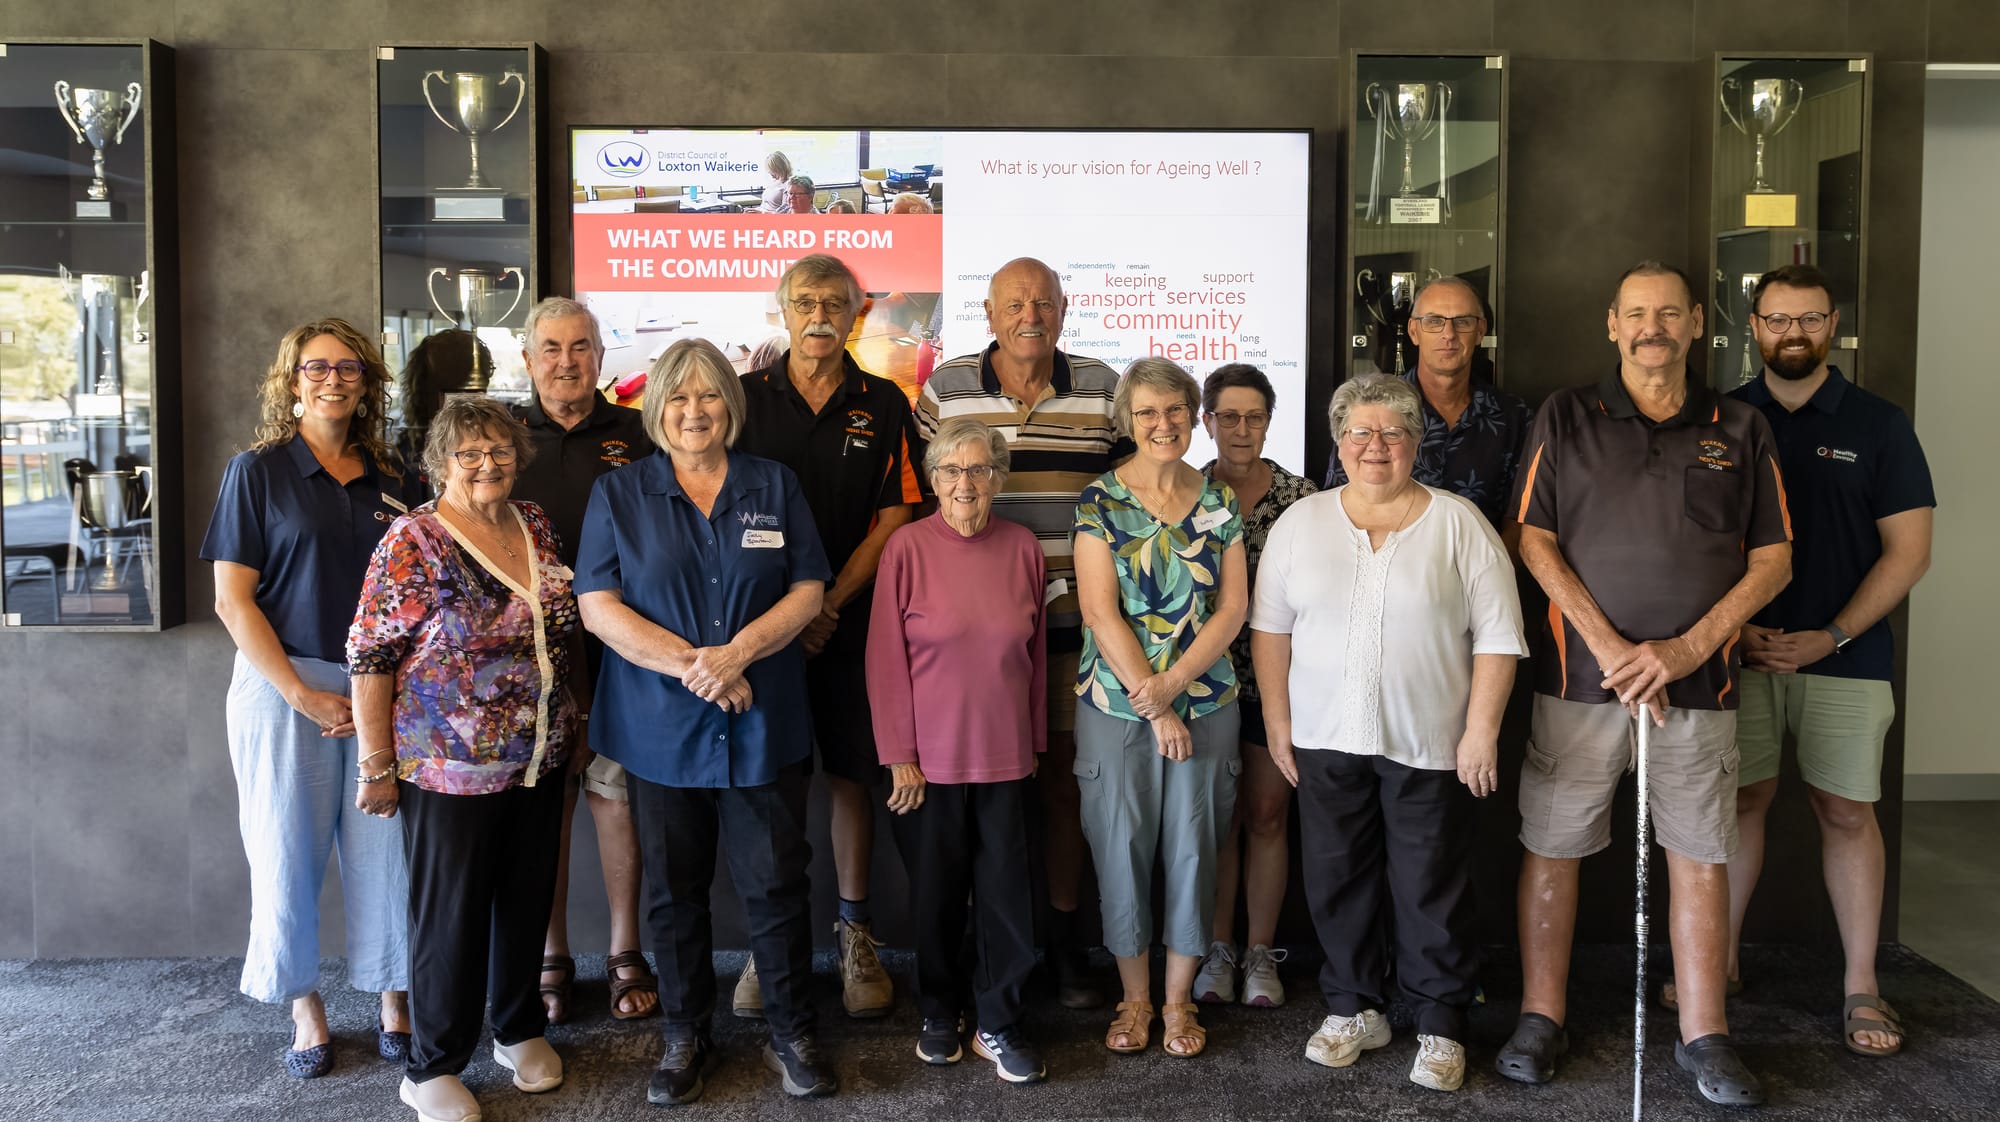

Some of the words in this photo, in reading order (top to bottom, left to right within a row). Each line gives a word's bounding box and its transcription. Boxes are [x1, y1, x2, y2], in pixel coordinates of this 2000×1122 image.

[657, 151, 686, 159] District
[687, 151, 718, 159] Council
[719, 151, 728, 159] of
[658, 161, 700, 172] Loxton
[704, 161, 759, 172] Waikerie
[980, 159, 1022, 177] What
[1027, 159, 1038, 177] is
[1041, 162, 1078, 181] your
[1081, 159, 1125, 177] vision
[1129, 159, 1152, 176] for
[1156, 159, 1211, 180] Ageing
[1215, 159, 1249, 176] Well
[1253, 160, 1262, 176] ?
[607, 229, 682, 249] WHAT
[688, 229, 726, 249] WE
[733, 229, 817, 249] HEARD
[824, 229, 893, 249] FROM
[607, 258, 655, 278] THE
[660, 258, 797, 279] COMMUNI
[1067, 261, 1116, 271] independently
[1126, 262, 1151, 270] remain
[957, 272, 993, 281] connecti
[1104, 272, 1167, 291] keeping
[1202, 270, 1255, 286] support
[1064, 290, 1156, 310] transport
[1166, 288, 1246, 305] services
[963, 301, 985, 311] poss
[955, 312, 988, 321] mainta
[1079, 310, 1099, 320] keep
[1103, 309, 1243, 334] community
[1176, 332, 1197, 340] needs
[1239, 332, 1261, 346] long
[1071, 338, 1121, 348] connections
[1149, 335, 1238, 361] health
[1243, 348, 1268, 358] mind
[1272, 359, 1298, 368] looking
